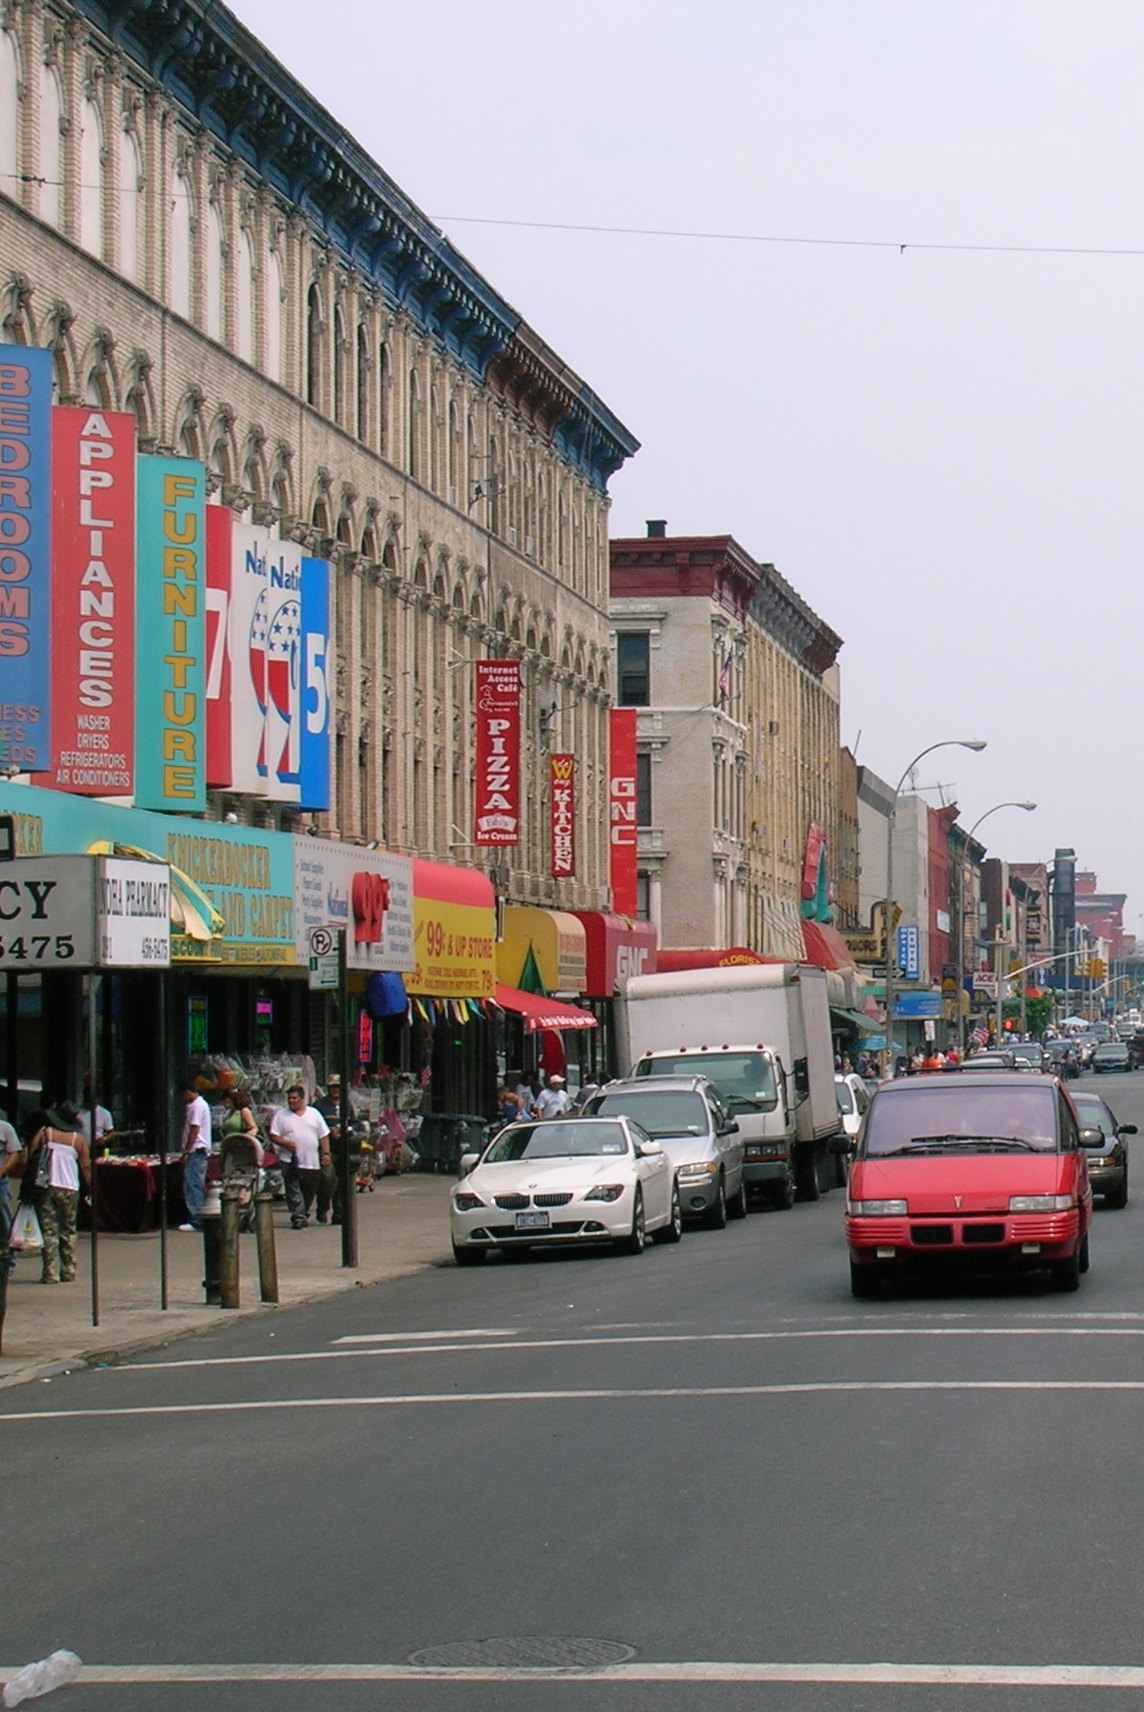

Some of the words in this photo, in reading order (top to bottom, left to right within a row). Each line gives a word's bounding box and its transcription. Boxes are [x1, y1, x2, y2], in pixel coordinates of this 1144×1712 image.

[0, 363, 30, 657] BEDROOMS
[78, 413, 114, 708] APPLIANCES
[163, 474, 196, 800] FURNITURE
[479, 665, 518, 674] Internet
[77, 714, 110, 731] WASHER
[77, 733, 110, 750] DRYERS
[56, 769, 70, 785] AIR
[72, 769, 131, 787] CONDITIONERS
[60, 751, 126, 769] REFRIGERATORS
[484, 718, 512, 810] PIZZA
[553, 789, 573, 871] KITCHEN
[611, 776, 635, 846] GNC
[477, 832, 489, 840] Ice
[491, 832, 517, 841] Cream
[167, 831, 271, 891] KNICKERBOCKER
[249, 893, 293, 940] CARPET
[427, 920, 447, 958] 99¢
[456, 935, 467, 958] UP
[468, 936, 493, 959] STORE
[908, 928, 917, 970] DENTAL
[616, 945, 649, 982] GNC
